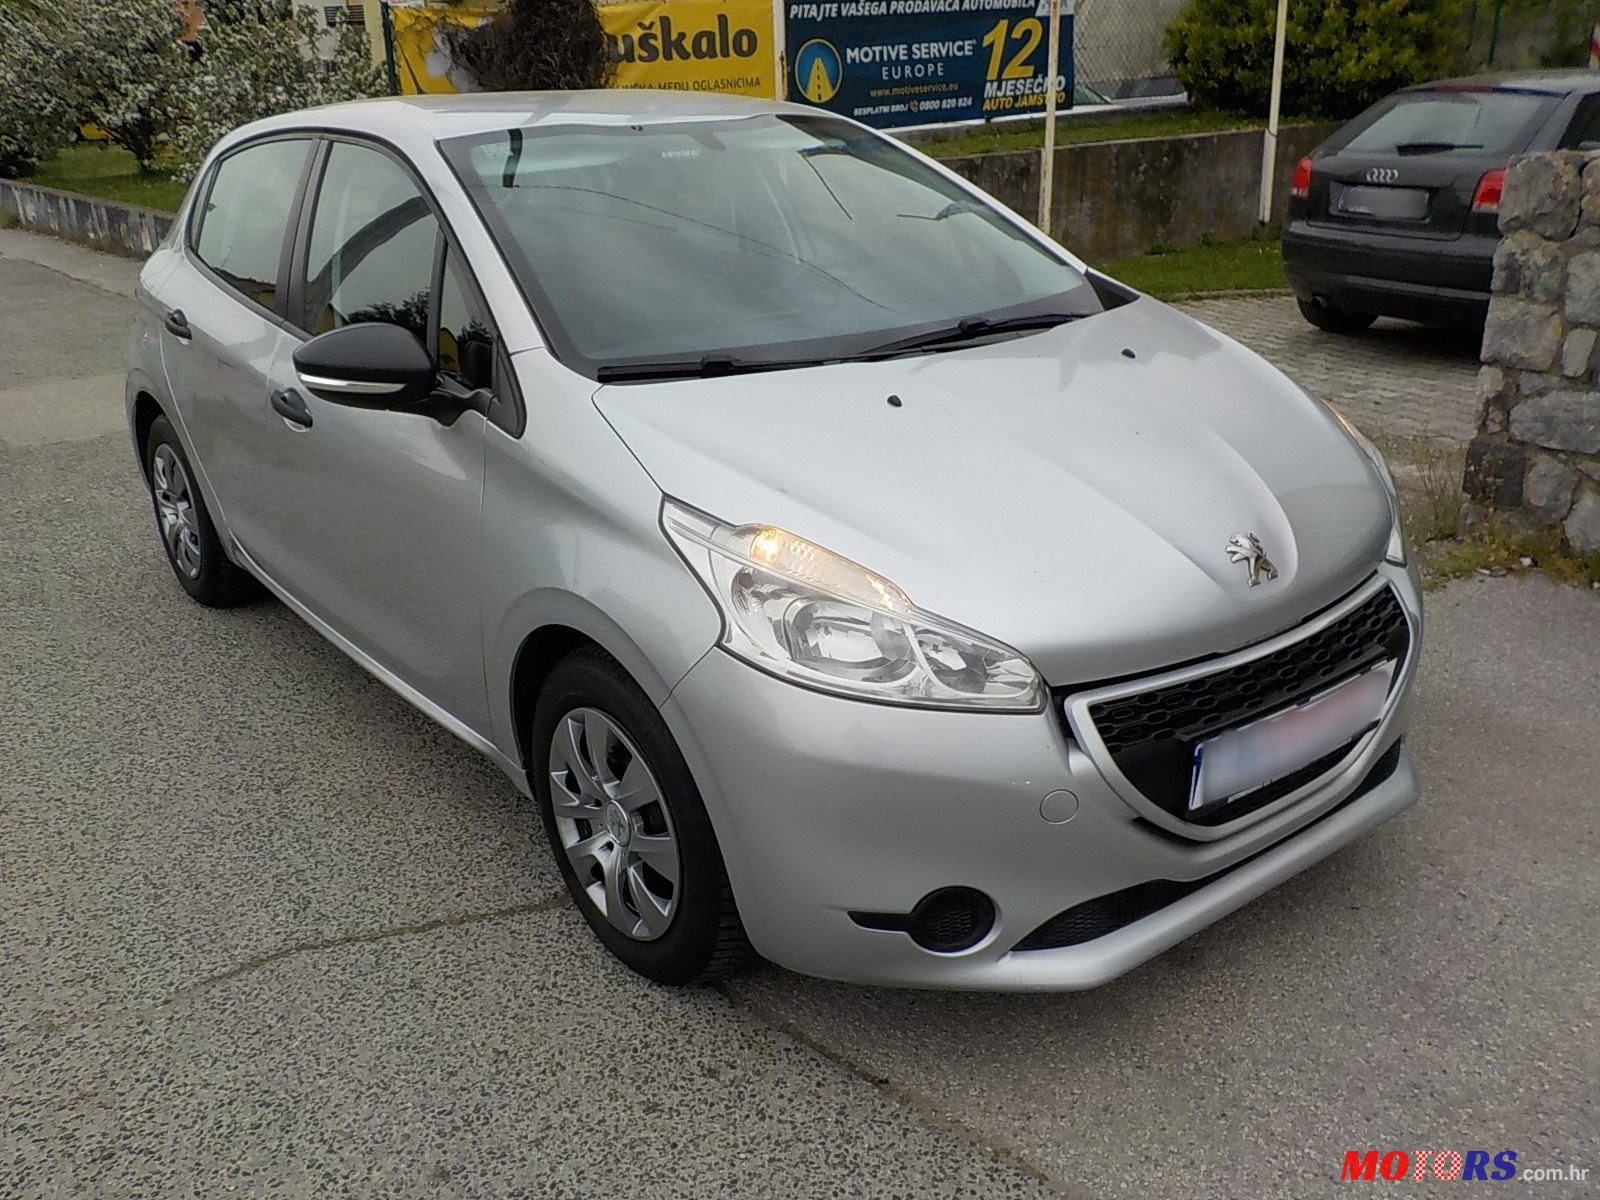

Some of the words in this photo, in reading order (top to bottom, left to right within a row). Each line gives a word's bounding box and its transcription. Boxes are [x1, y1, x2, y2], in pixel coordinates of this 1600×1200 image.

[789, 3, 839, 21] PITAJTE
[607, 14, 758, 64] uškalo
[846, 44, 908, 65] MOTIVE
[911, 40, 974, 60] SERVICE
[982, 17, 1043, 81] 12
[881, 62, 945, 80] EUROPE
[692, 76, 761, 91] OGLASNICIMA
[869, 82, 959, 97] www.motiveservice.eu
[853, 104, 891, 117] BESPLATNI
[890, 103, 909, 114] BROJ
[919, 99, 941, 111] 0800
[983, 96, 1014, 112] AUTO
[1014, 91, 1066, 108] JAMSTO
